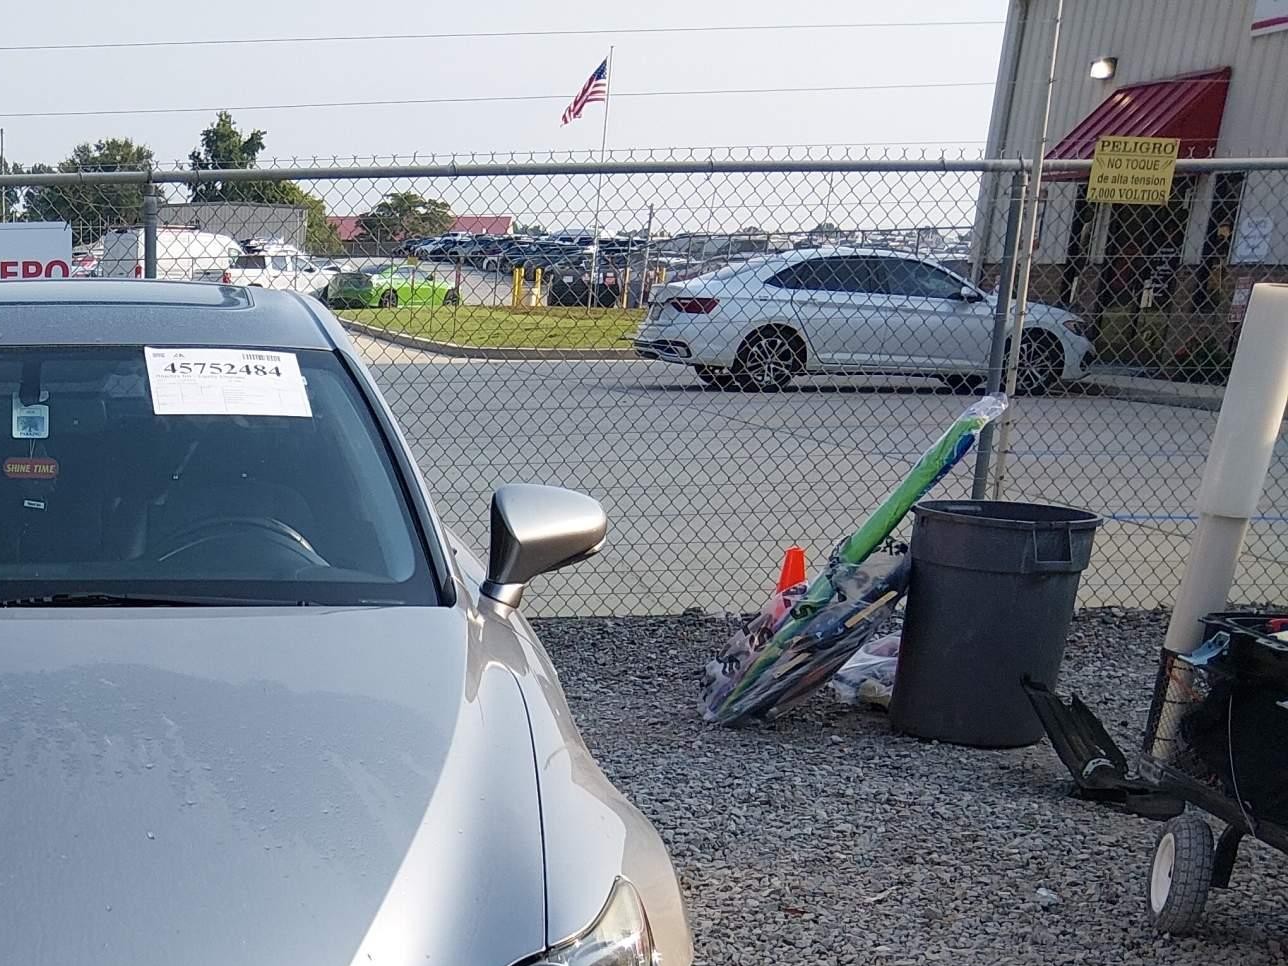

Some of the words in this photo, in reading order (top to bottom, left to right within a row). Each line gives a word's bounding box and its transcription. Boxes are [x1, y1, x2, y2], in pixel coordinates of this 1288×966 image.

[1100, 140, 1175, 155] PELIGRO
[1107, 158, 1122, 169] NO
[1126, 159, 1161, 171] TOQUE
[1097, 174, 1109, 184] de
[1111, 174, 1129, 185] alta
[1132, 174, 1166, 186] tension
[1118, 189, 1167, 201] VOLTIOS
[163, 361, 282, 377] 45752484
[6, 463, 31, 473] SHINE
[34, 463, 56, 473] TIME
